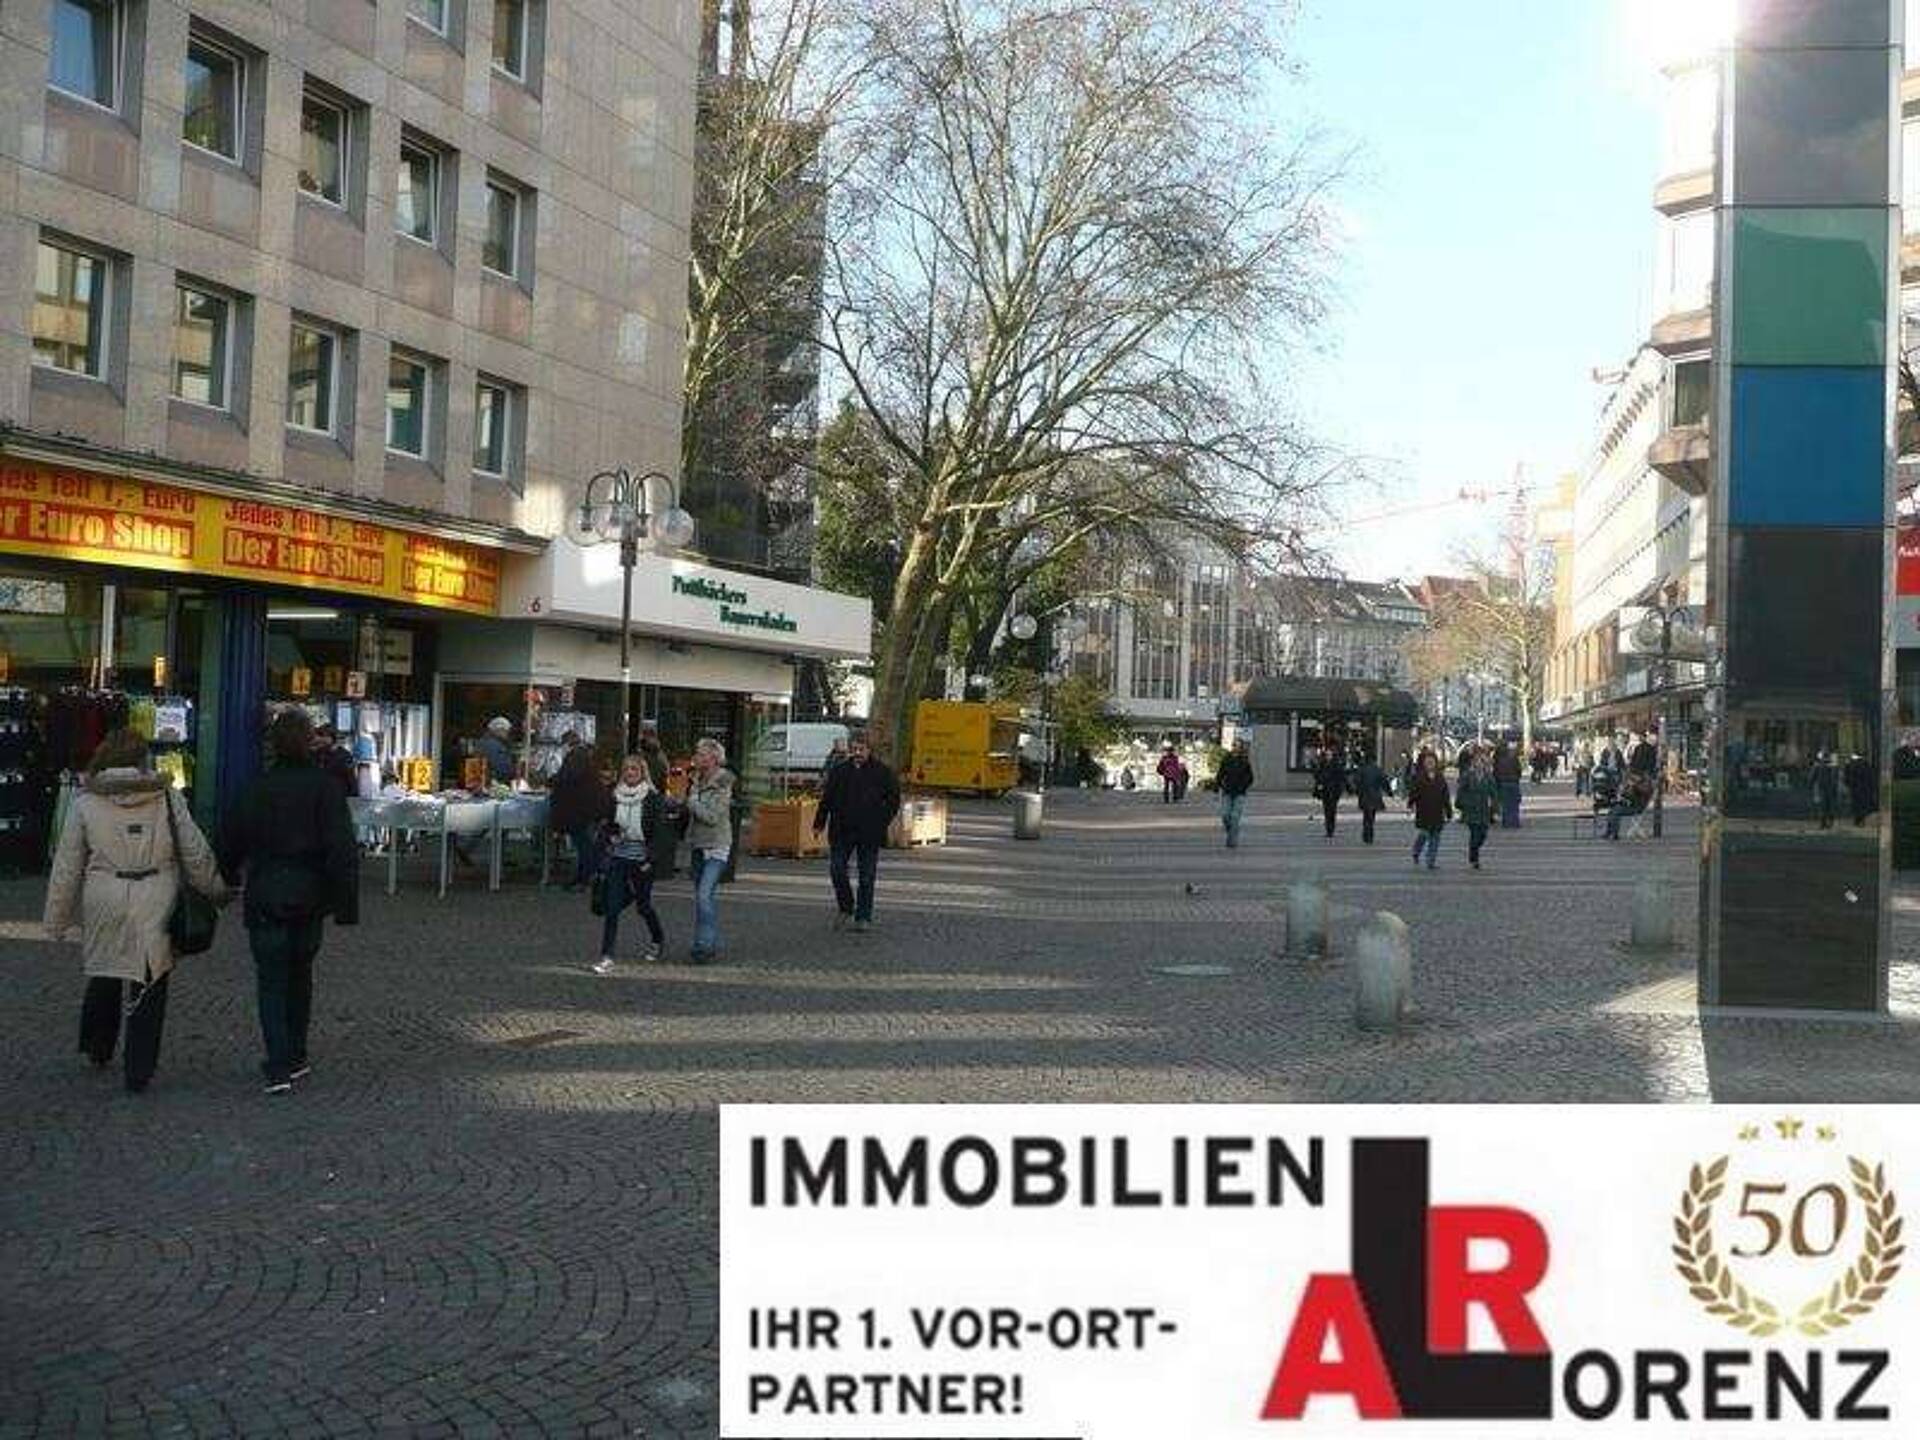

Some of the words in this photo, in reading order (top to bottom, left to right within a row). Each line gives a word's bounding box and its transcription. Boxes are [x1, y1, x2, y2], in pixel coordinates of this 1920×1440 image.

[143, 485, 195, 513] Euro
[30, 502, 105, 546] Euro
[113, 513, 192, 559] Shop
[226, 530, 273, 567] Der
[277, 536, 329, 573] Euro
[331, 545, 384, 584] Shop
